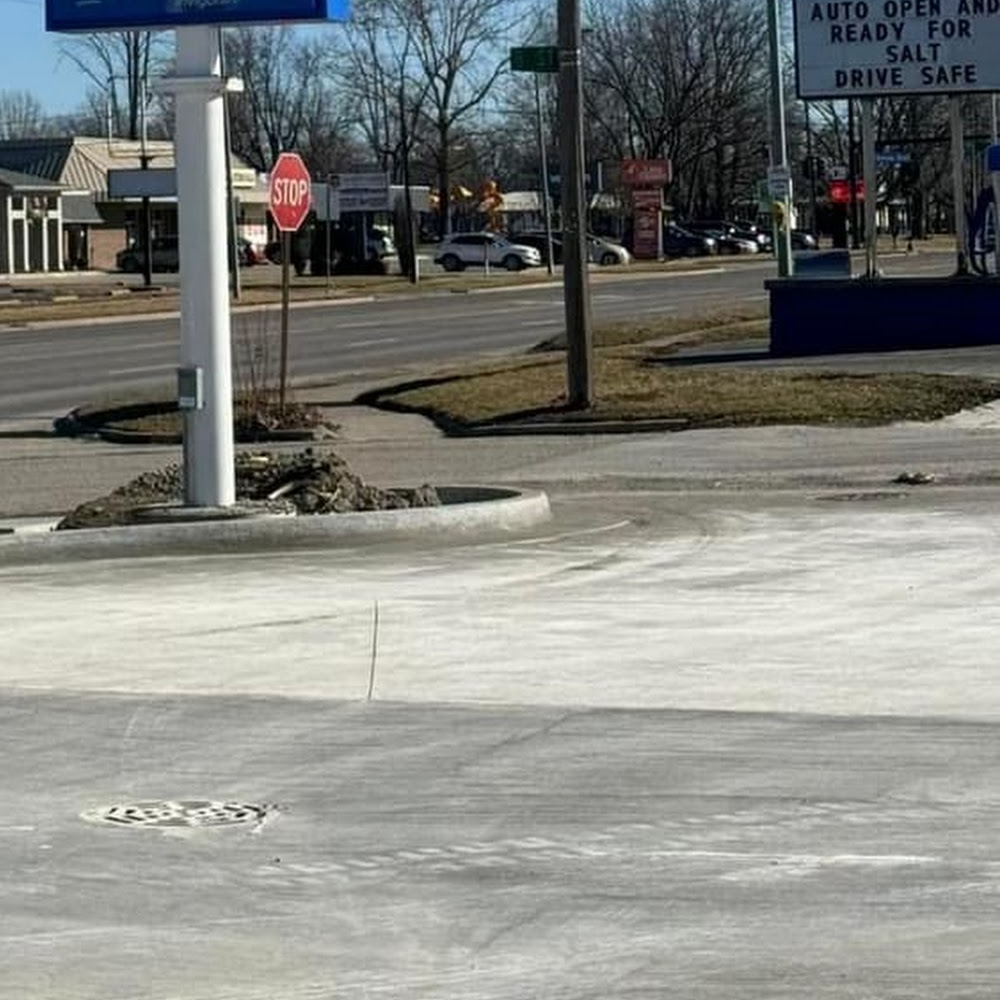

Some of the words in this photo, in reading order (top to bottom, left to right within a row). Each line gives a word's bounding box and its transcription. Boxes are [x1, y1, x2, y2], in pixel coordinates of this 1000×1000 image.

[811, 2, 868, 21] AUTO
[884, 0, 940, 18] OPEN
[831, 23, 904, 43] READY
[928, 20, 971, 38] FOR
[887, 43, 940, 63] SALT
[835, 68, 902, 88] DRIVE
[921, 65, 976, 84] SAFE
[274, 179, 307, 205] STOP
